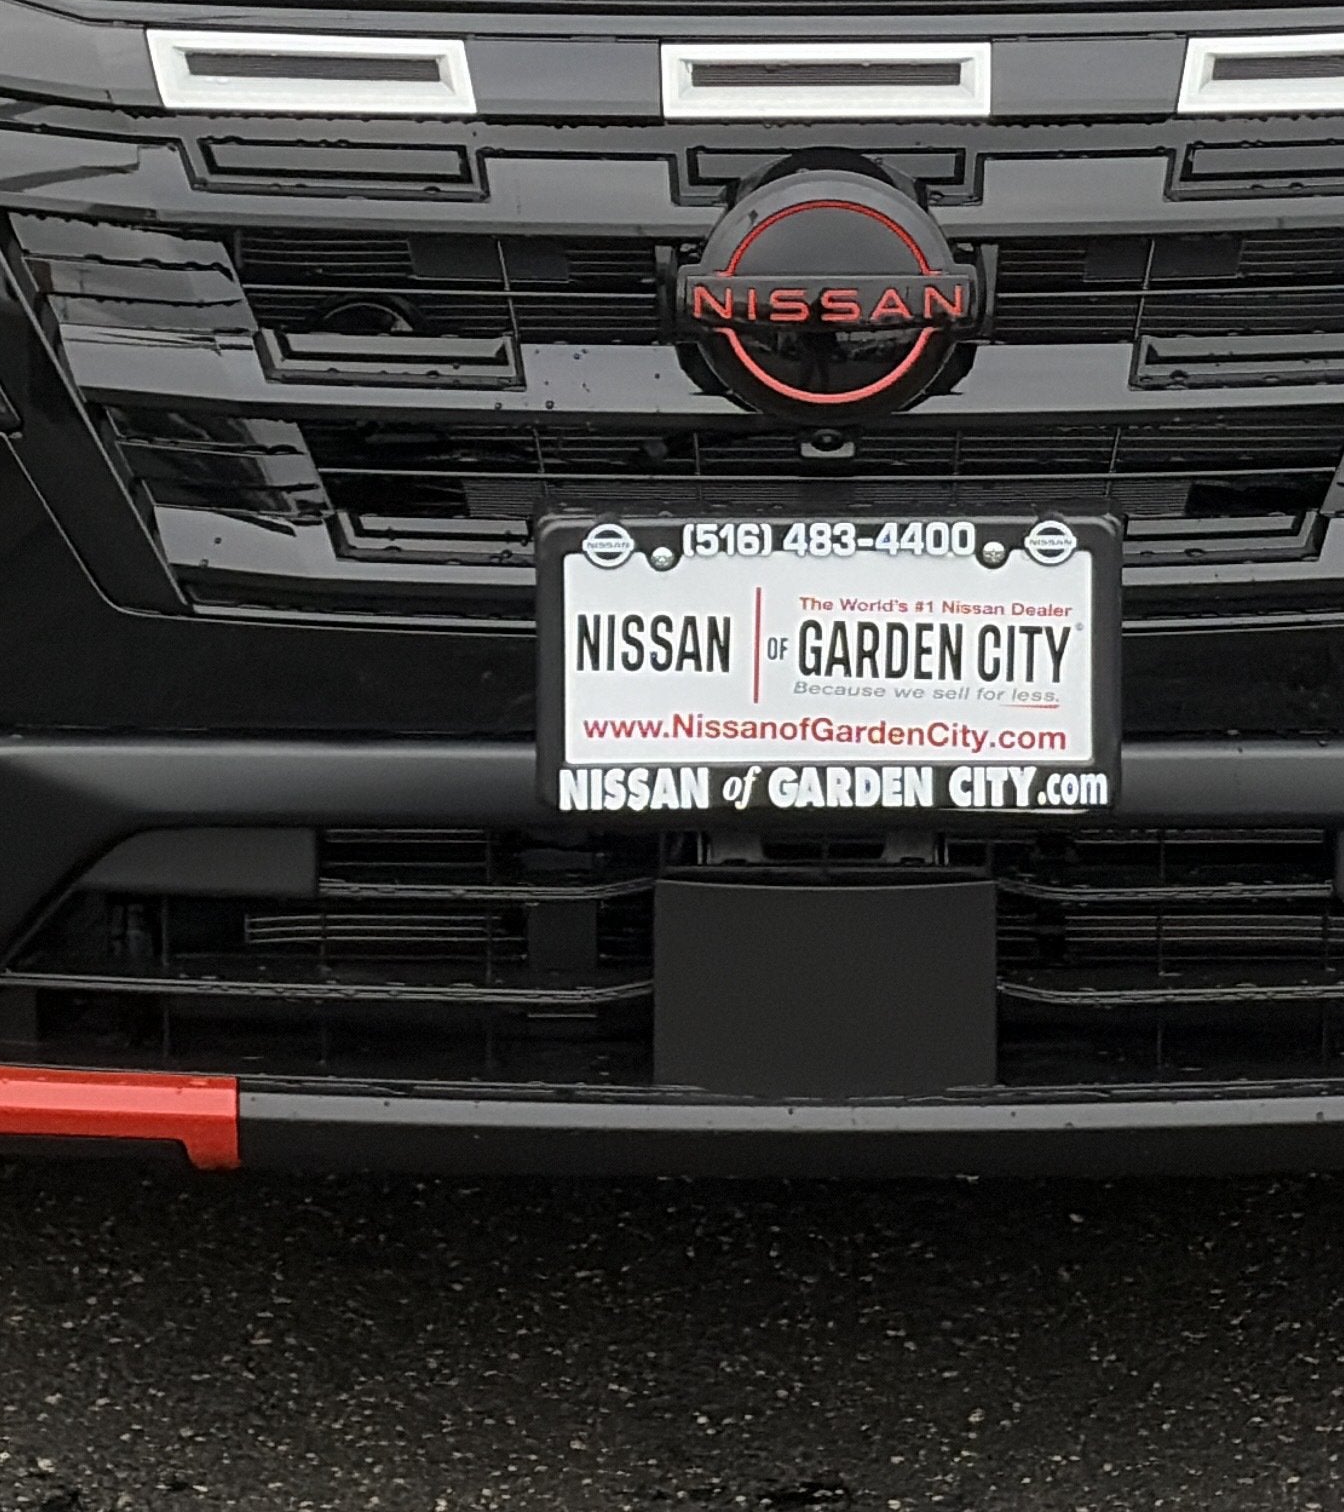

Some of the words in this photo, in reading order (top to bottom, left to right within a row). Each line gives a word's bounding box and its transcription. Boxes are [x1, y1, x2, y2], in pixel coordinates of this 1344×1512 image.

[692, 285, 963, 322] NISSAN
[682, 522, 772, 557] (516)
[783, 521, 976, 556] 483-4400
[799, 597, 834, 611] The
[840, 598, 908, 613] World's
[915, 600, 934, 614] #1
[942, 600, 1005, 615] Nissan
[1011, 602, 1073, 617] Dealer
[576, 614, 731, 672] NISSAN
[767, 637, 789, 660] OF
[798, 619, 963, 681] GARDEN
[977, 623, 1071, 683] CITY
[793, 681, 886, 698] Because
[894, 687, 924, 699] we
[932, 687, 970, 701] sell
[976, 687, 1005, 701] for
[1011, 688, 1060, 703] less.
[583, 713, 1067, 754] www.NissanofGardenCity.com
[559, 767, 709, 811] NISSAN
[722, 765, 762, 810] of
[768, 766, 934, 808] GARDEN
[949, 765, 1108, 807] CITY.com
